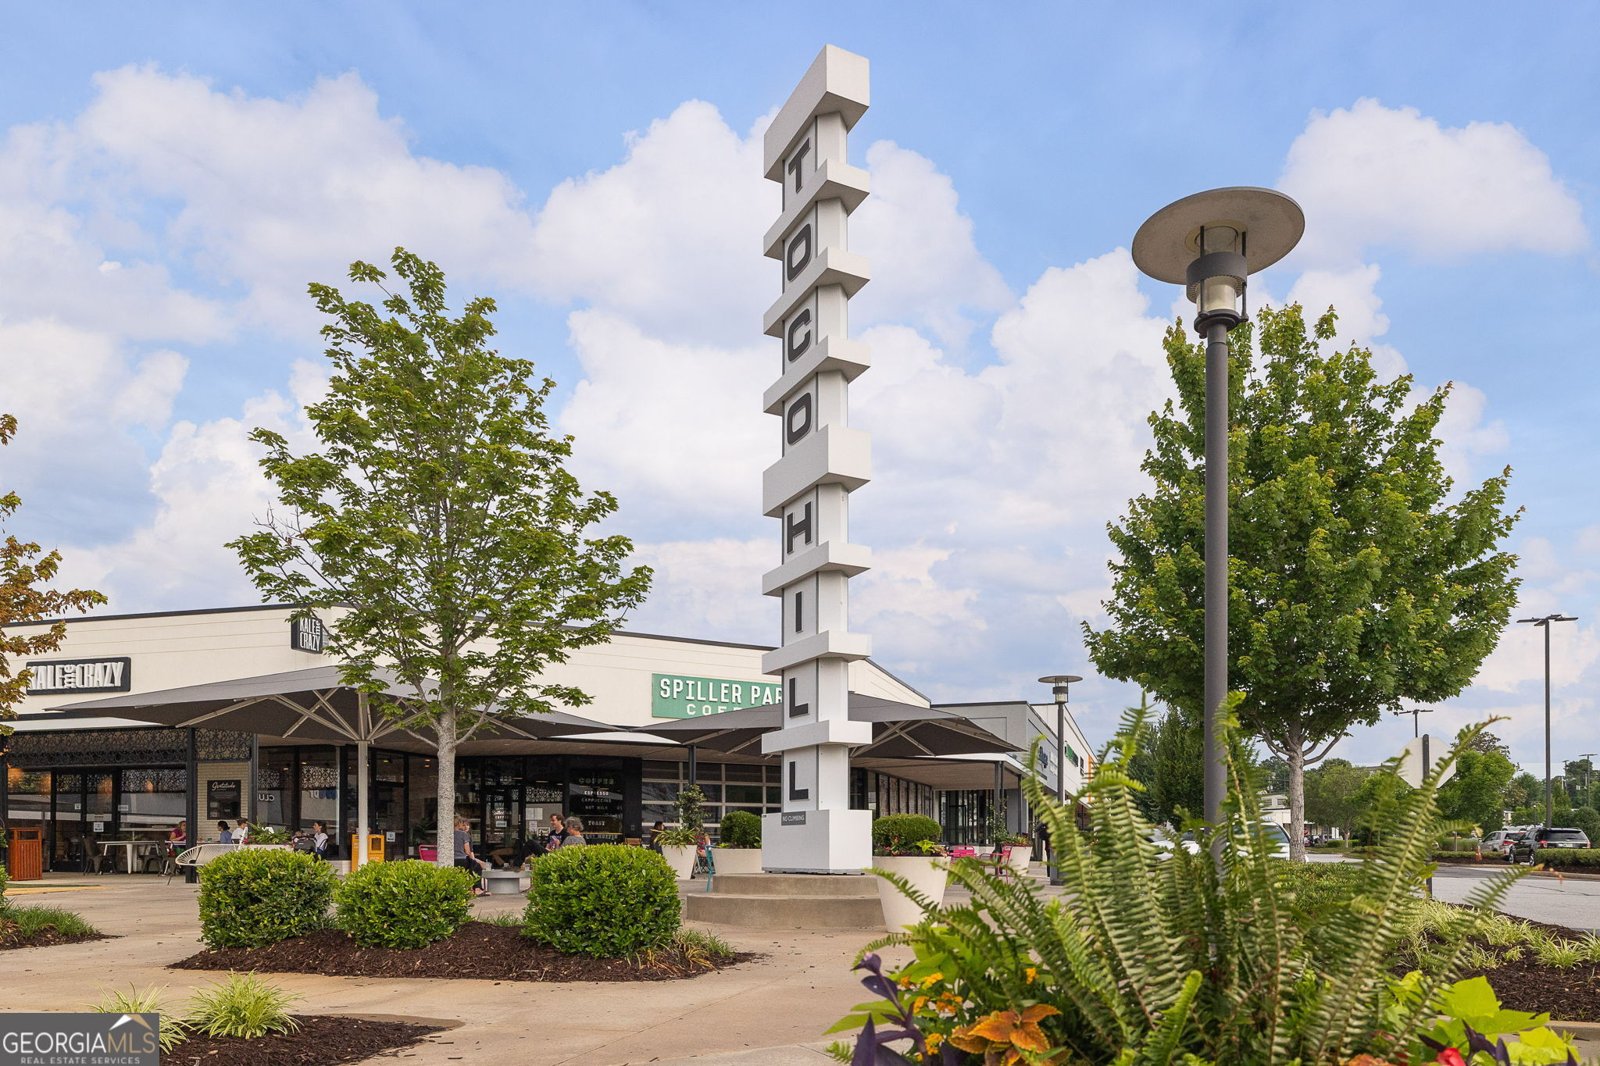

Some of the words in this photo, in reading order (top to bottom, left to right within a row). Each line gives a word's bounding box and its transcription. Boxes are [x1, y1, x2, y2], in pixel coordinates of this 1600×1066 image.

[788, 137, 812, 446] TOCO
[300, 616, 316, 634] KALE
[300, 632, 321, 652] CRAZY
[787, 501, 811, 801] HILL
[75, 662, 124, 688] CRAZY
[660, 678, 743, 704] SPILLER
[750, 685, 783, 705] PAR
